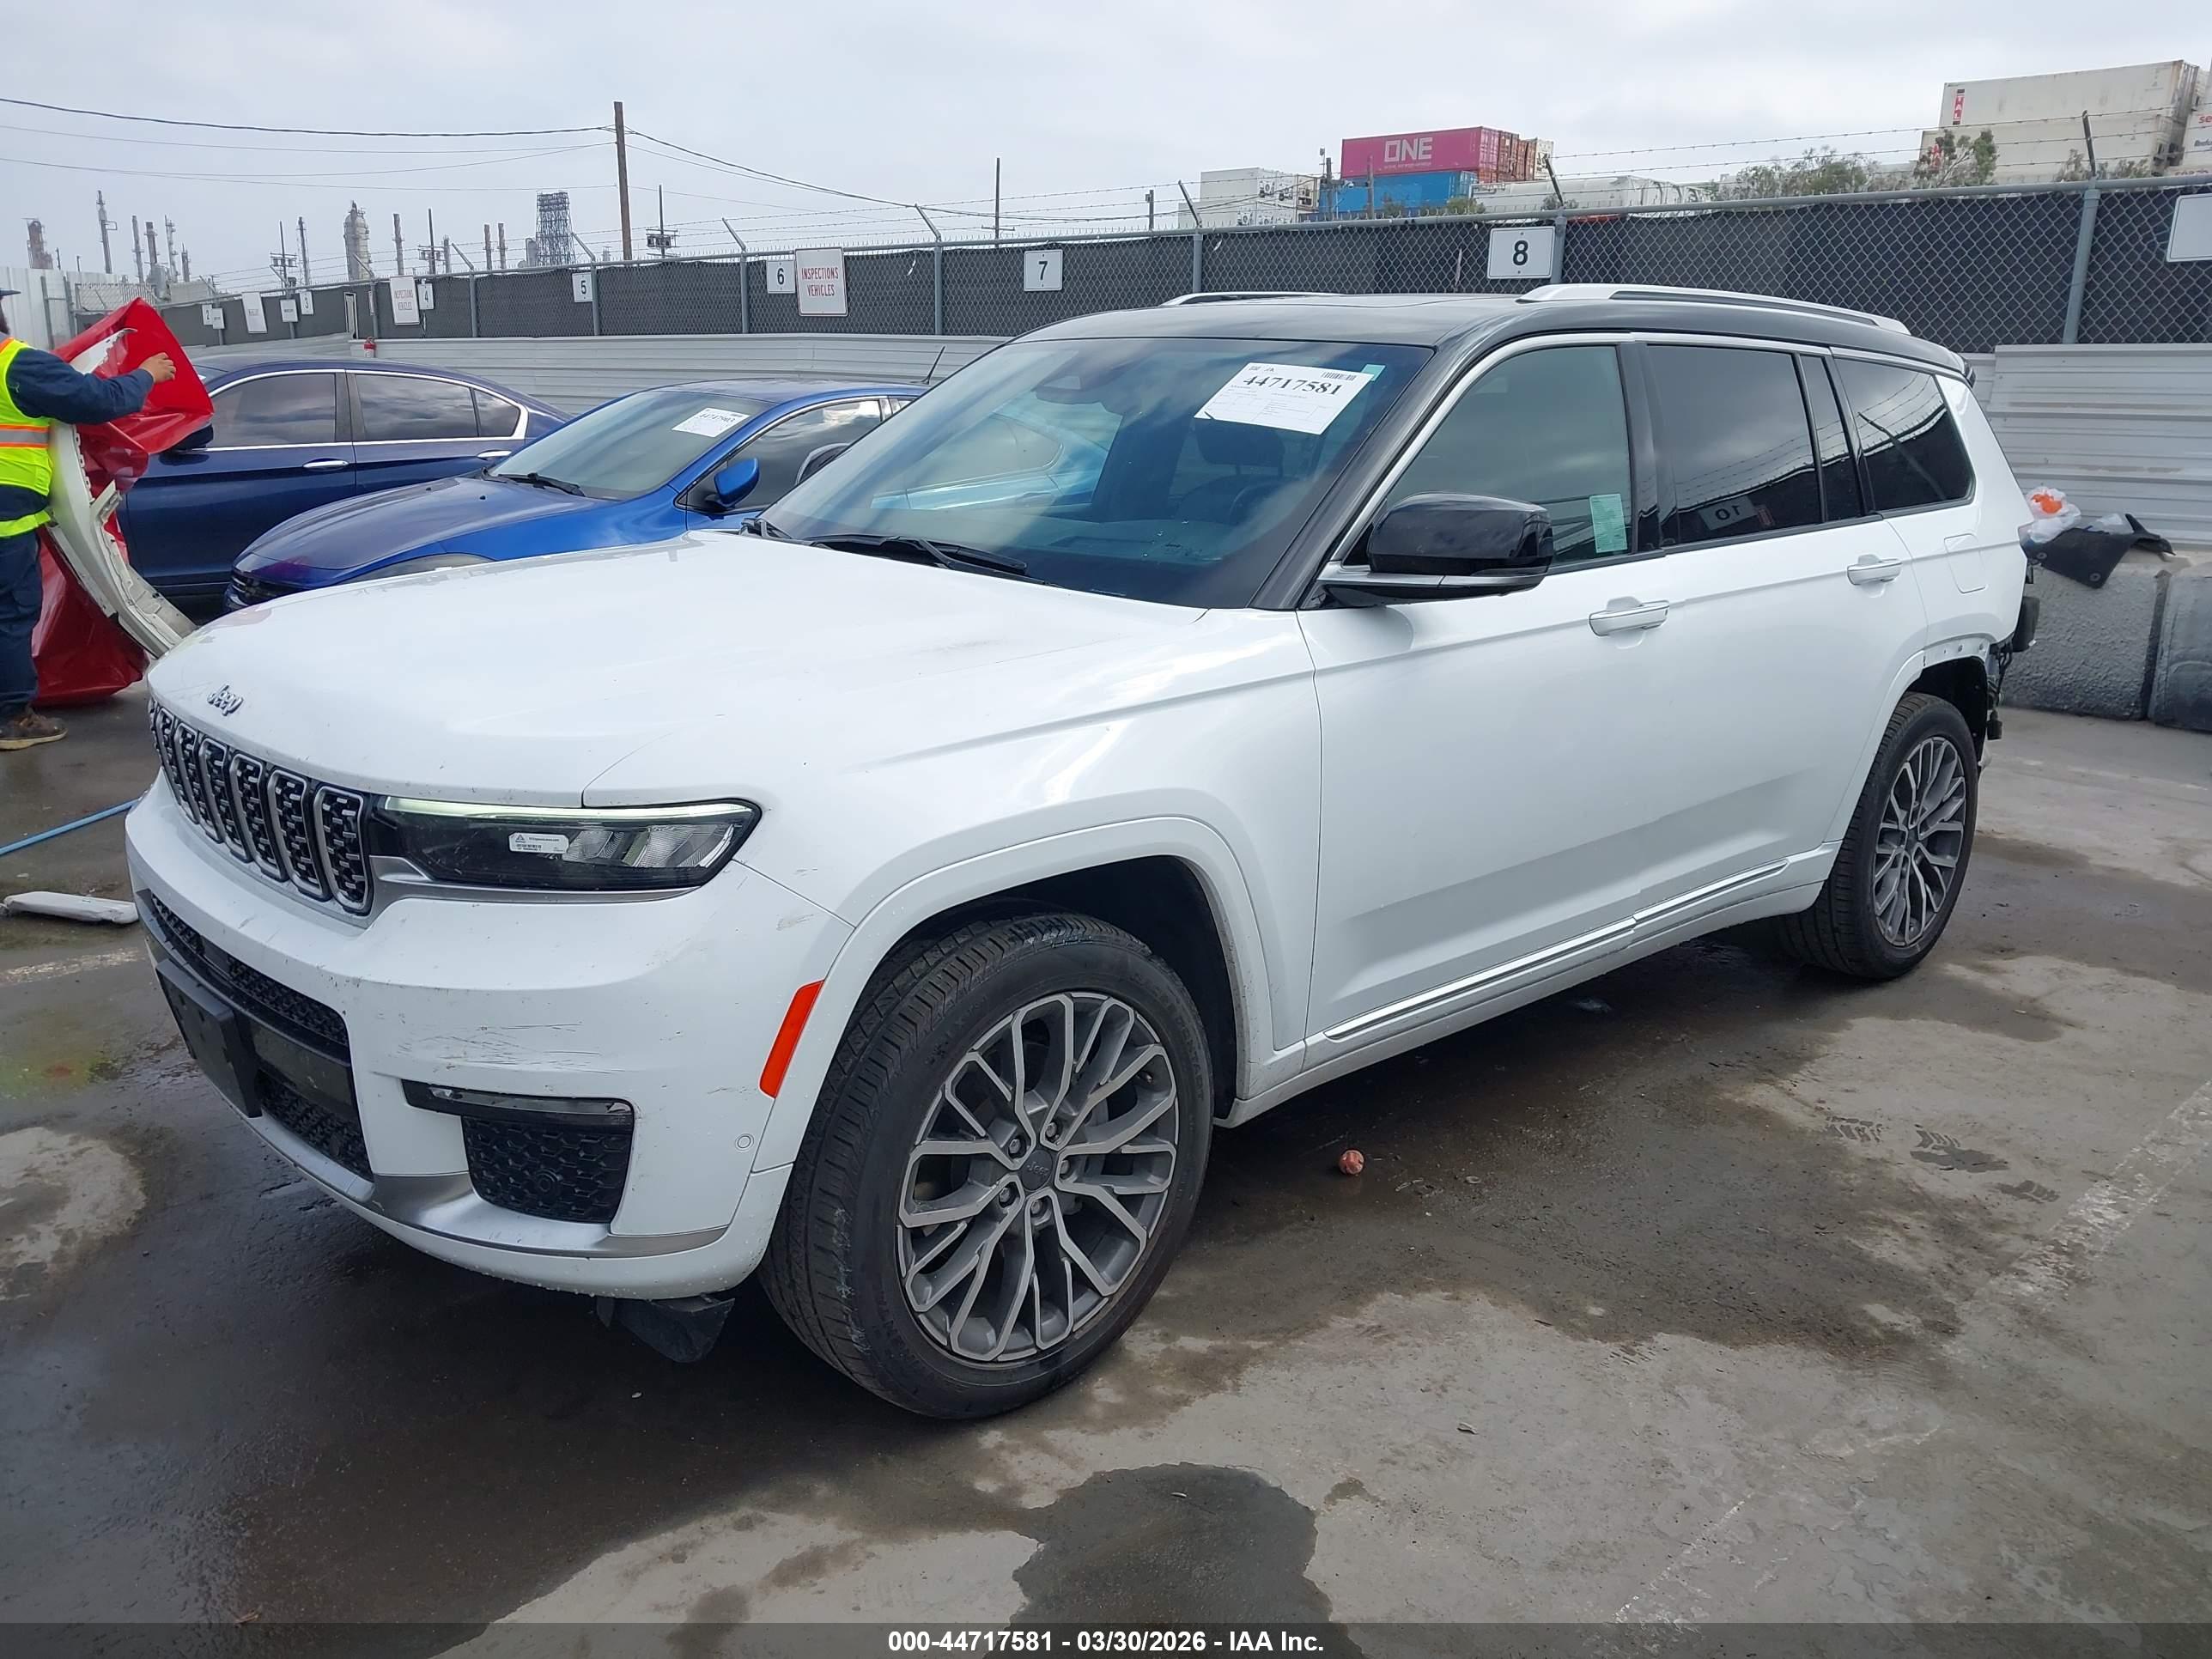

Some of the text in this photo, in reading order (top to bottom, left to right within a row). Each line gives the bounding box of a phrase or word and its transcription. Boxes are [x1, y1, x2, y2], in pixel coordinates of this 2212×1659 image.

[1384, 137, 1433, 162] ONE
[1513, 240, 1528, 266] 8
[777, 267, 785, 285] 6
[801, 267, 839, 280] INSPECTIONS
[1038, 260, 1048, 281] 7
[424, 290, 429, 301] 4
[580, 280, 587, 295] 5
[807, 284, 835, 296] VEHICLES
[303, 297, 309, 309] 3
[1243, 375, 1342, 396] 44717581
[207, 684, 244, 717] Jeep
